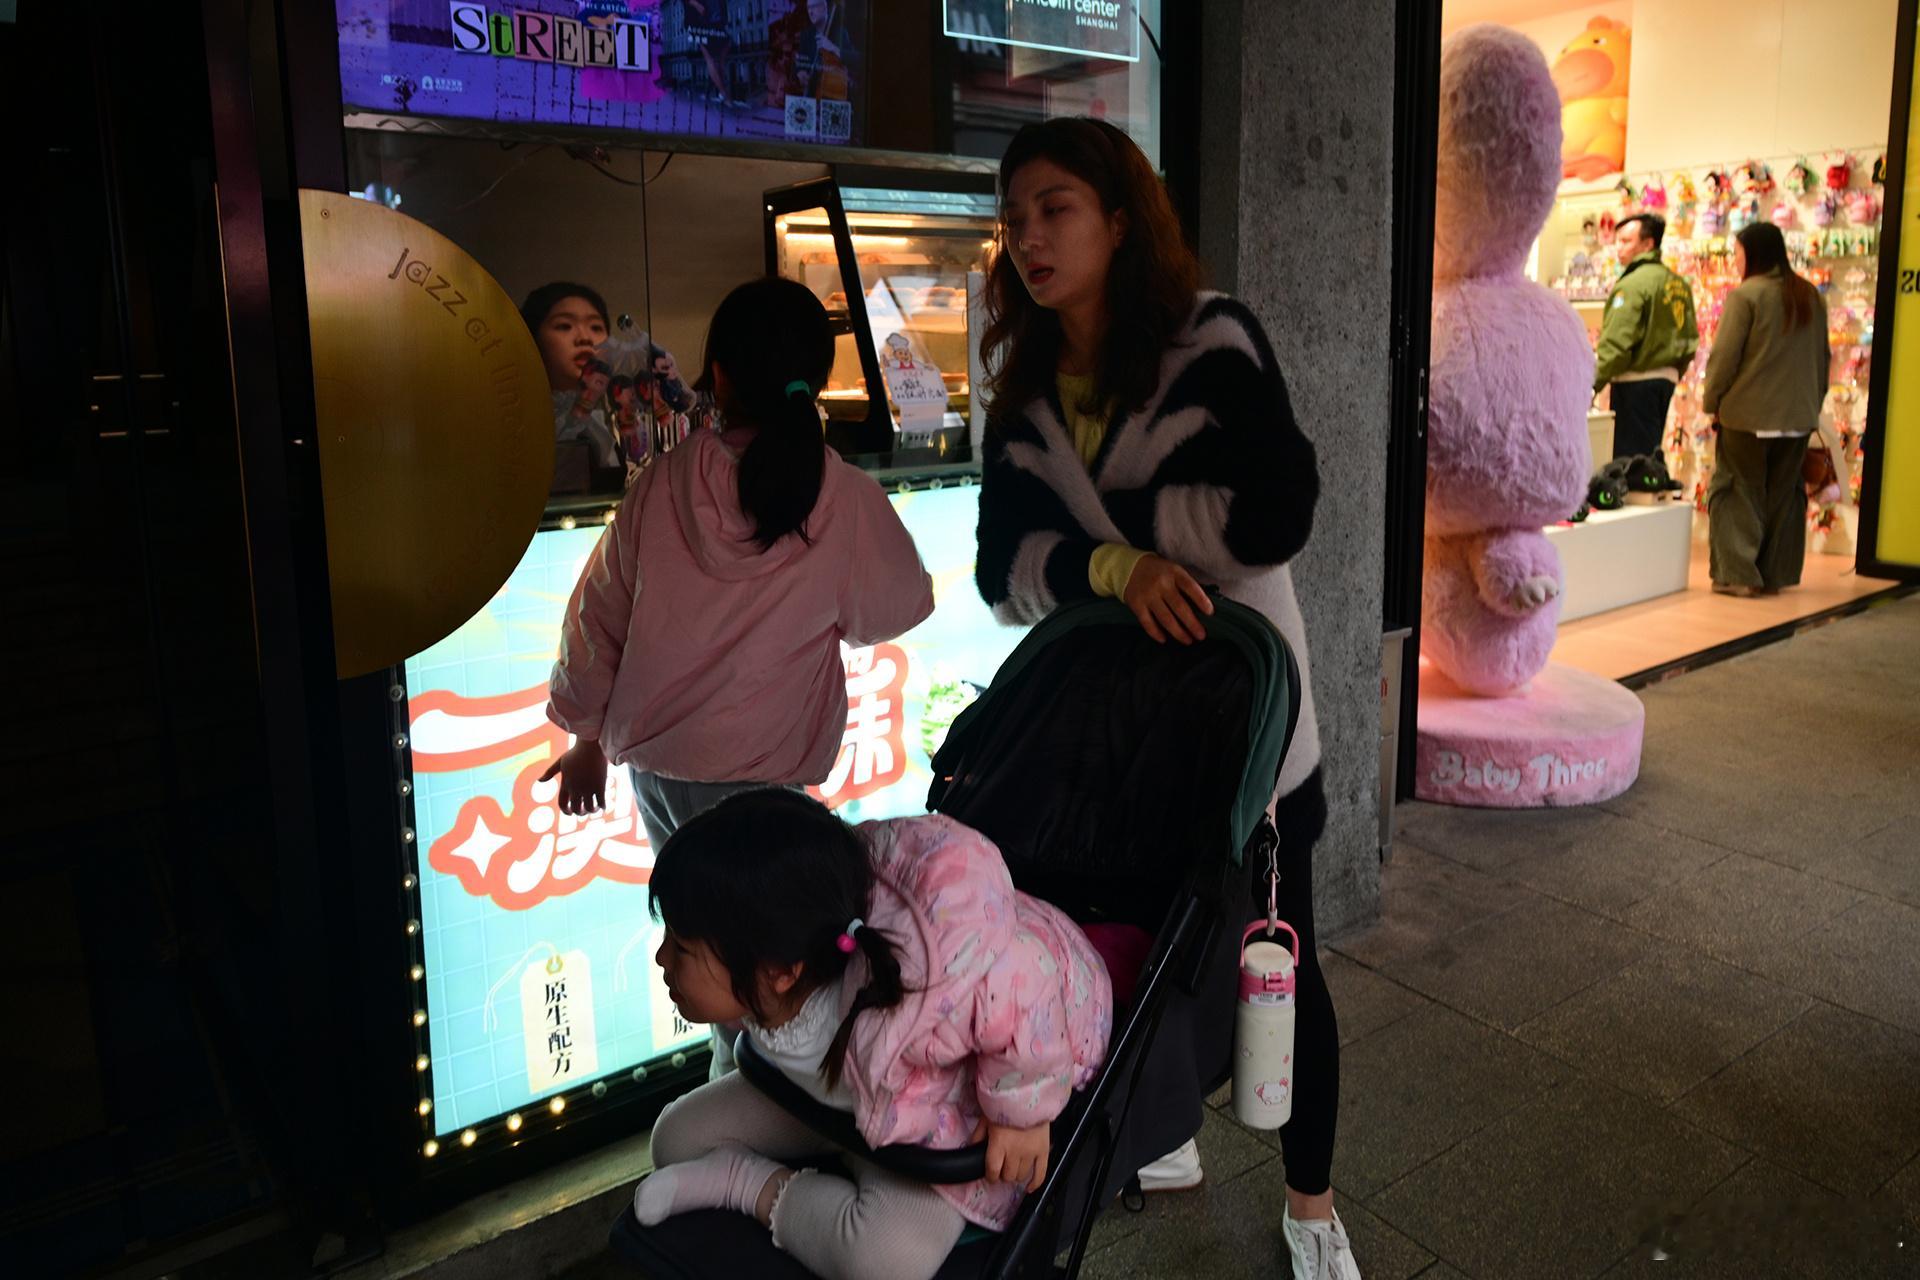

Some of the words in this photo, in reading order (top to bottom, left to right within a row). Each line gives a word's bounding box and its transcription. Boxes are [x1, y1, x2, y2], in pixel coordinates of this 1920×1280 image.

[1074, 0, 1121, 18] center
[1075, 14, 1119, 31] SHANGHAI
[387, 246, 469, 318] jazz
[464, 315, 505, 358] at
[1430, 751, 1521, 793] Baby
[1529, 753, 1607, 790] Three
[544, 977, 573, 1078] 原生配方
